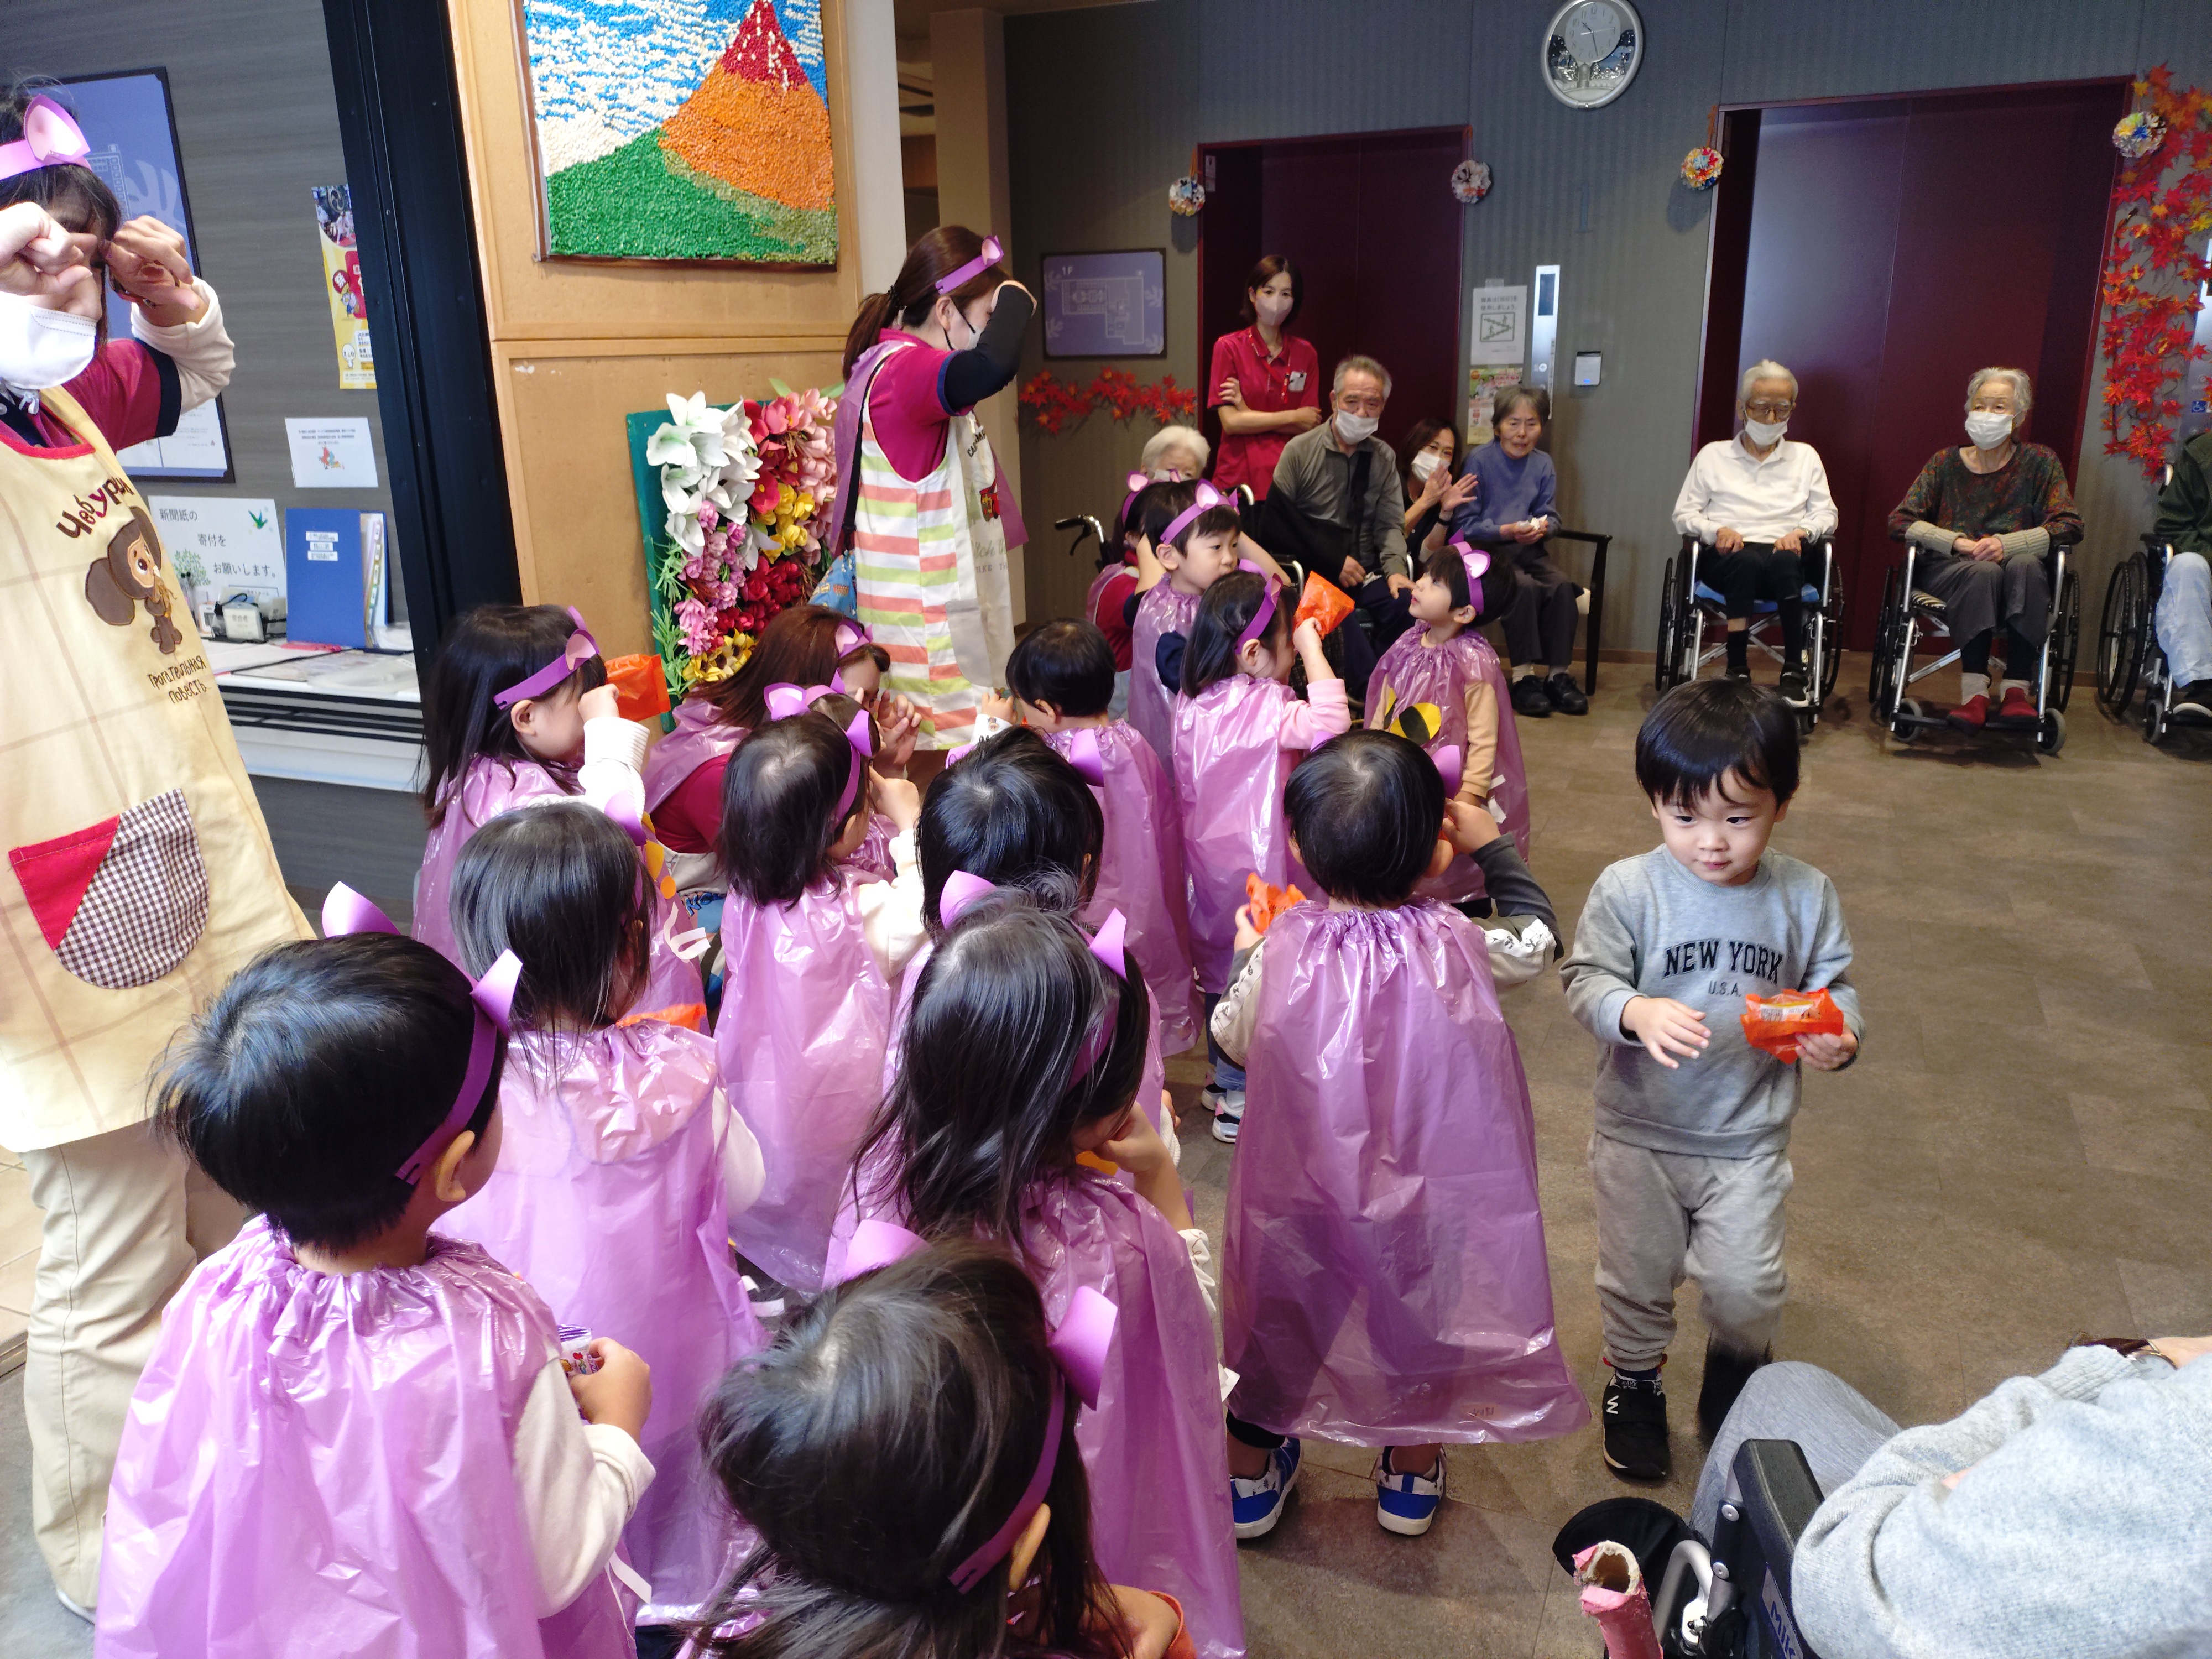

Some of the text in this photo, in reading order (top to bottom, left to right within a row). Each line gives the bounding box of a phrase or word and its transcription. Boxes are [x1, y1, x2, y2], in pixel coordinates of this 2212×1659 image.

[1062, 266, 1073, 275] 1F
[159, 508, 198, 521] 新聞紙の
[197, 533, 226, 547] 寄付を
[213, 562, 276, 578] お願いします。
[1662, 939, 1783, 985] NEW YORK
